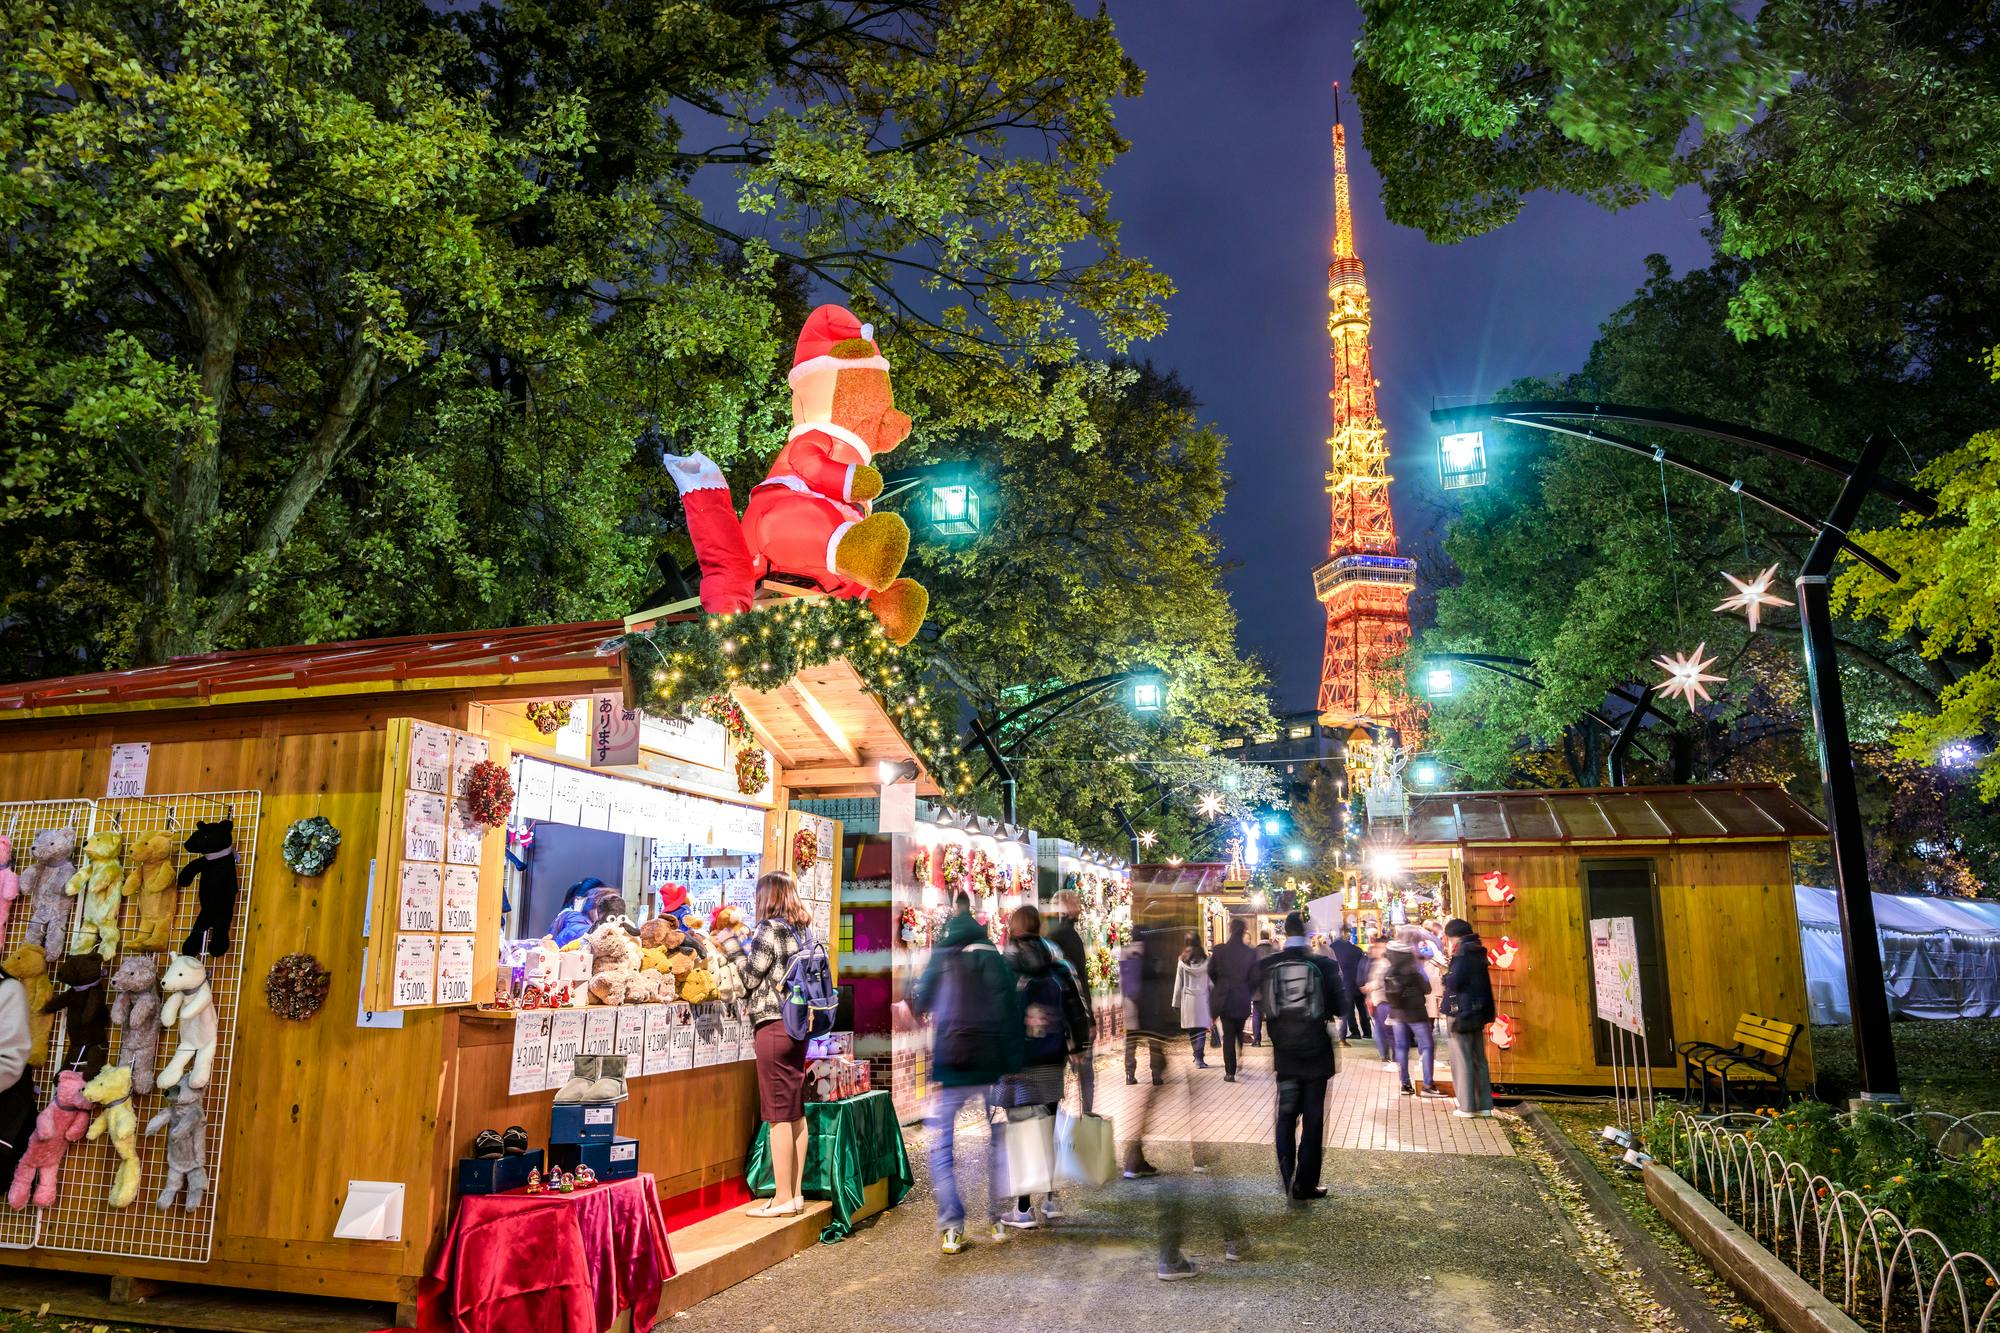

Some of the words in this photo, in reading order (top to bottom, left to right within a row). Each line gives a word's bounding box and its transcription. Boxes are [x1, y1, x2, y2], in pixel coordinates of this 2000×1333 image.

[597, 698, 612, 762] あります
[113, 781, 140, 796] ¥3,000-
[416, 770, 444, 791] ¥3,000-
[412, 838, 440, 859] ¥3,000-
[406, 911, 434, 931] ¥1,000-
[447, 910, 473, 930] ¥5,000-
[400, 982, 428, 1003] ¥5,000-
[442, 980, 469, 1001] ¥3,000-
[618, 1036, 641, 1056] ¥4,500-
[516, 1045, 544, 1069] ¥3,000-
